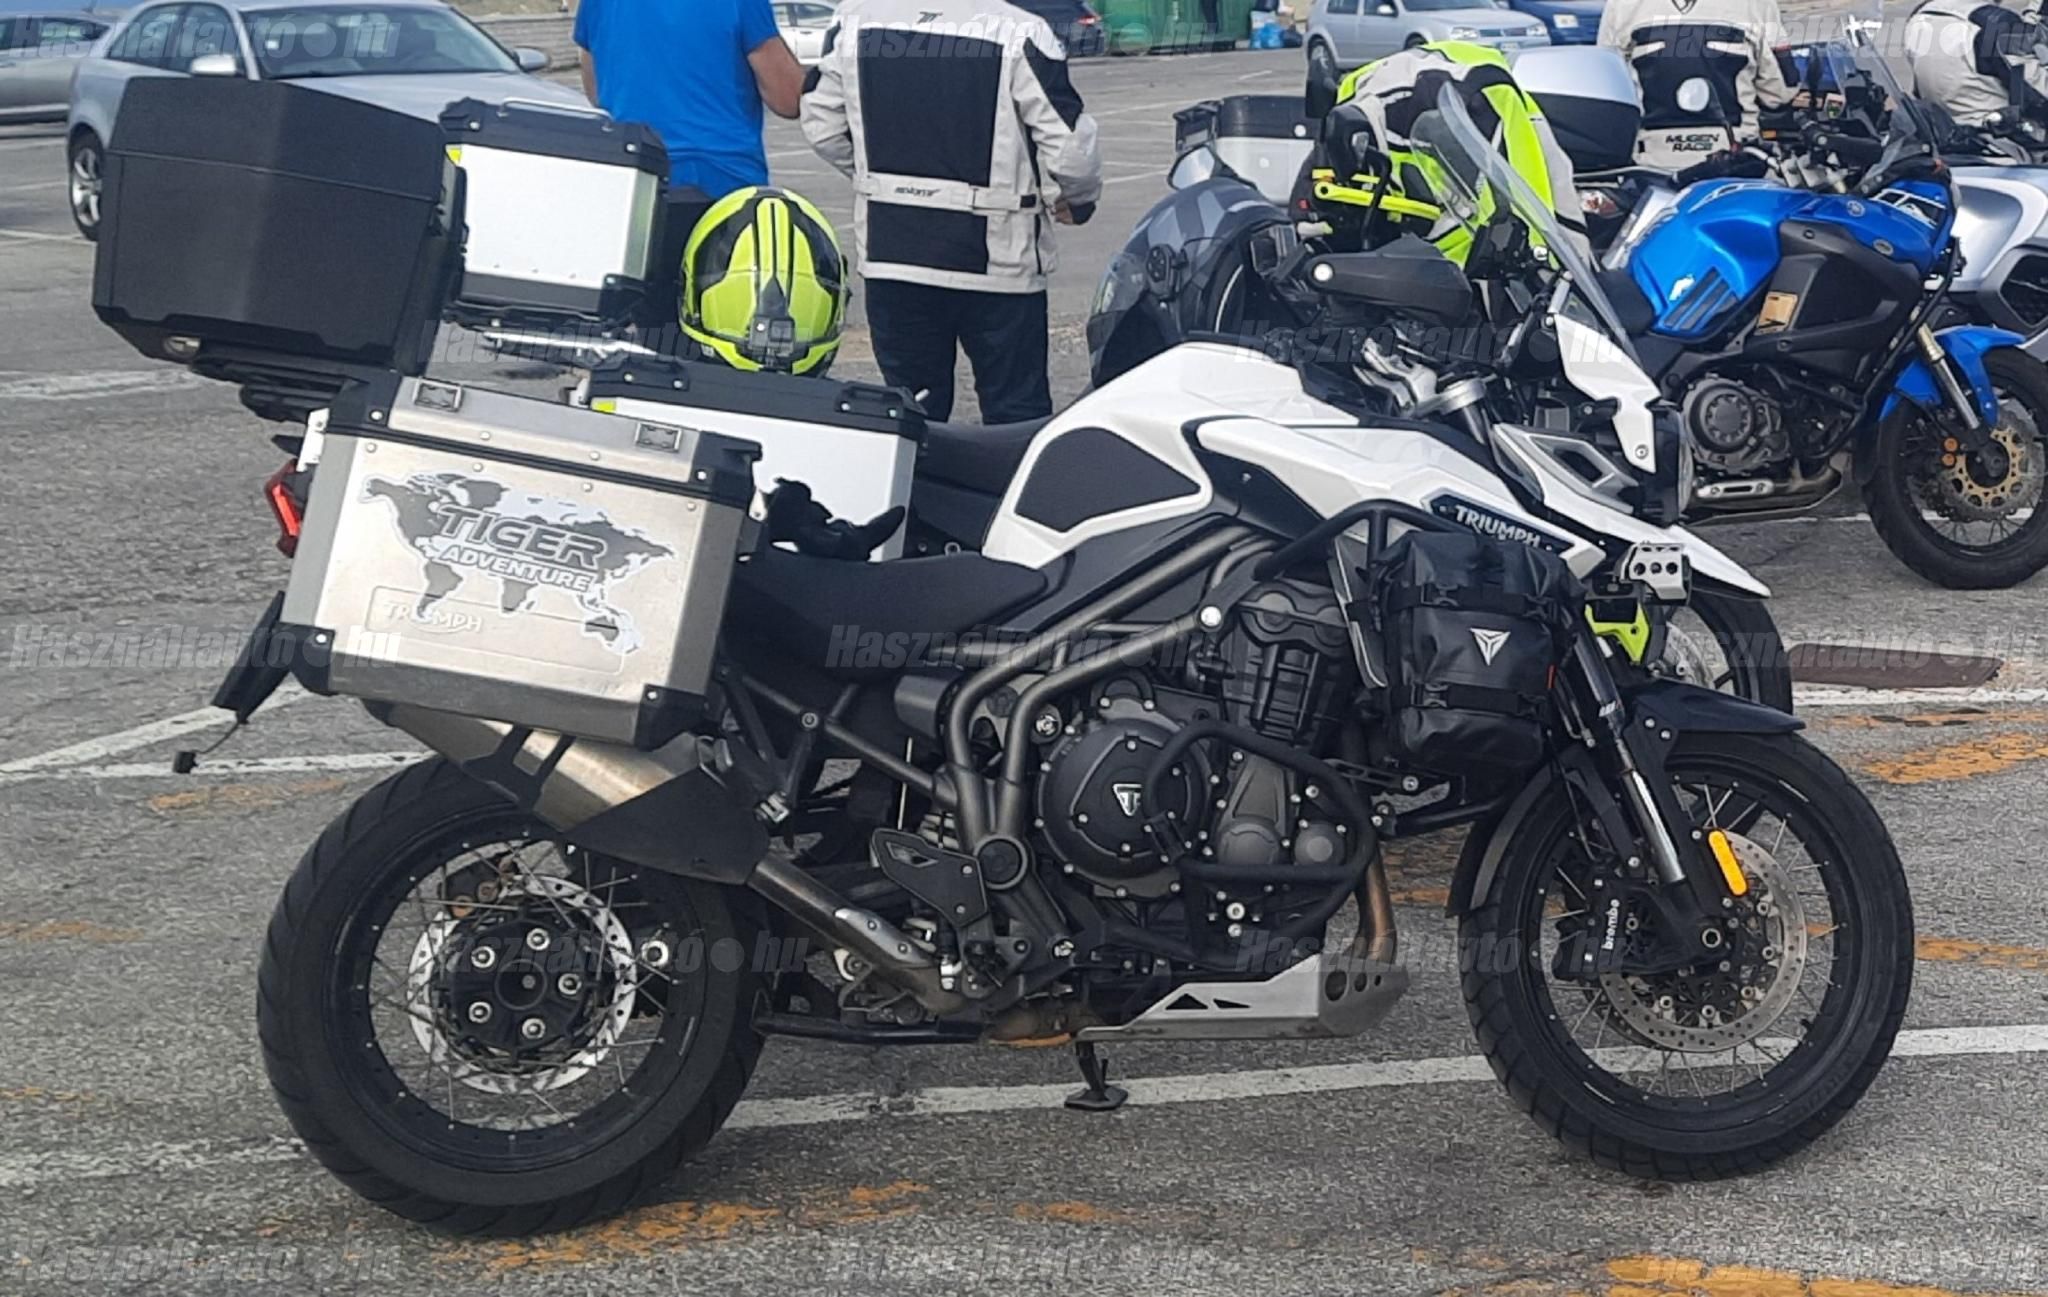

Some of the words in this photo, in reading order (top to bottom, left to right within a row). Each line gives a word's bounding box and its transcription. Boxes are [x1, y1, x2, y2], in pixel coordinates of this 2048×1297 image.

[1665, 133, 1721, 143] MUGEN
[1672, 142, 1713, 152] RACE
[438, 504, 607, 570] TIGER
[1456, 504, 1541, 548] TRIUMPH
[438, 544, 597, 593] ADVENTURE
[385, 603, 482, 633] TRMPH
[1601, 899, 1620, 950] brembo
